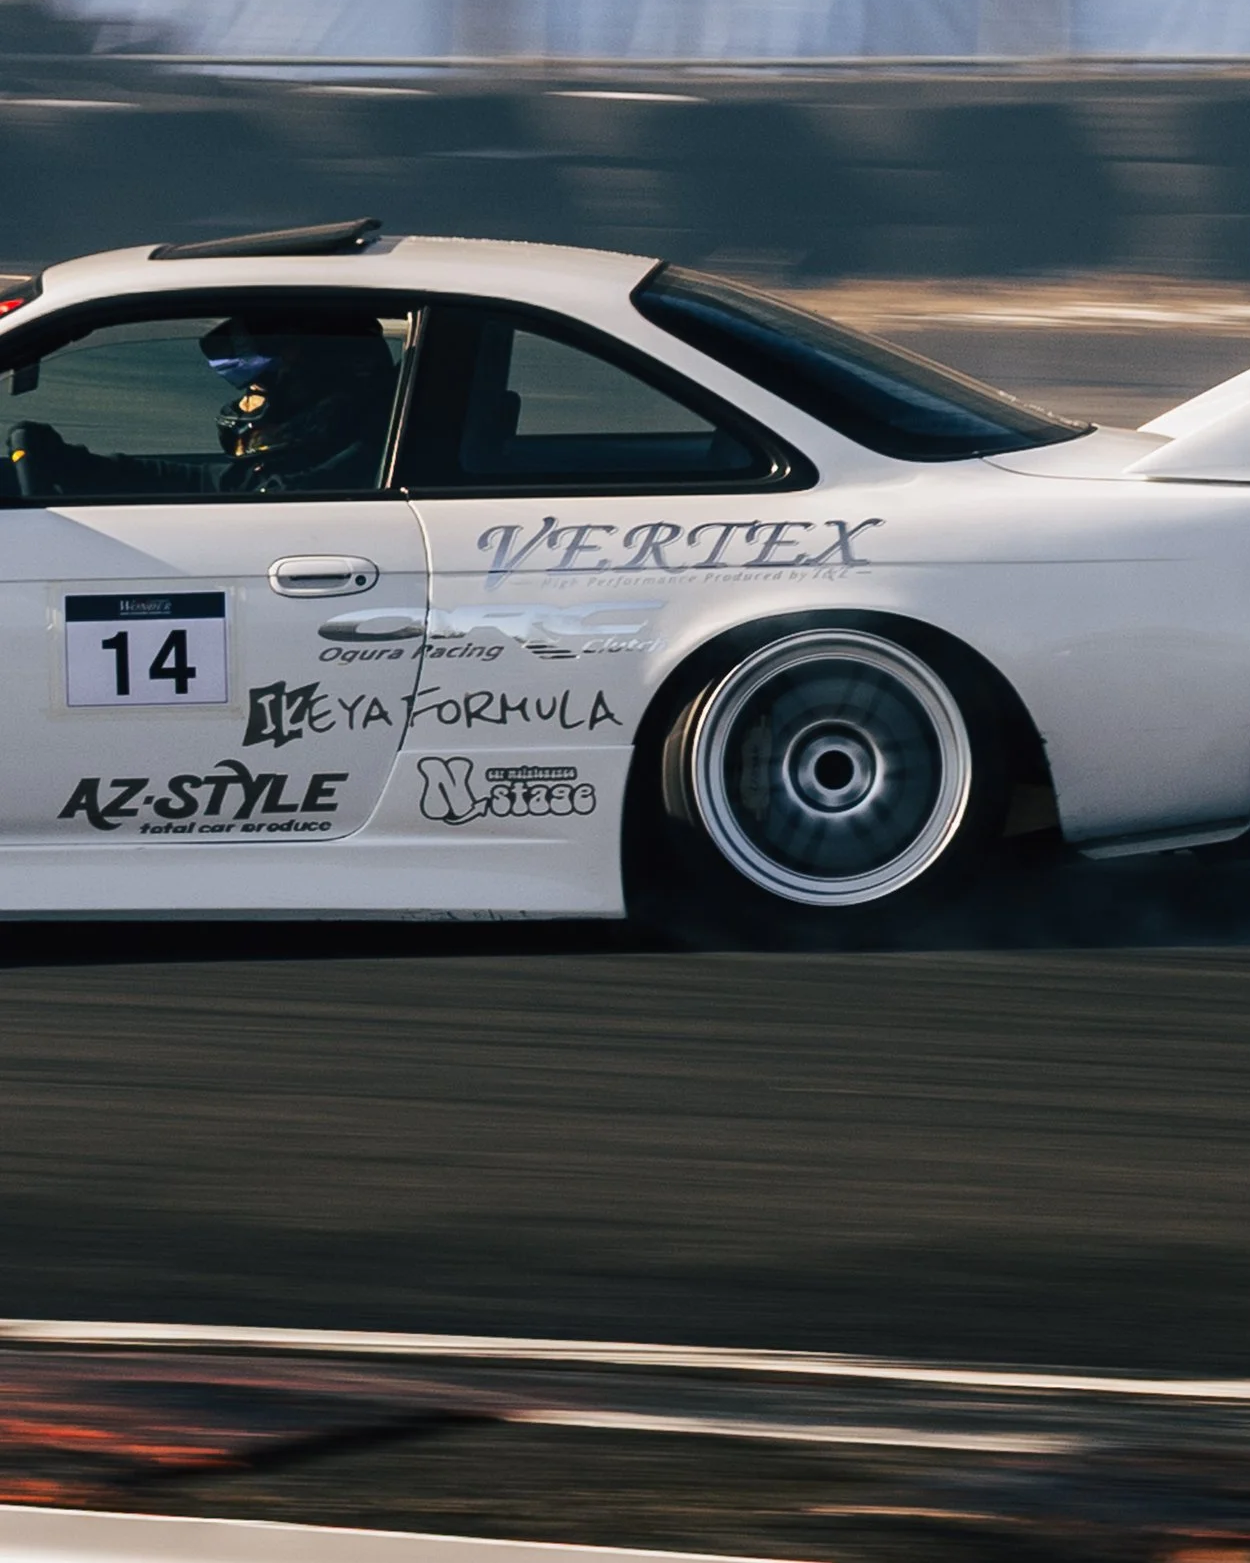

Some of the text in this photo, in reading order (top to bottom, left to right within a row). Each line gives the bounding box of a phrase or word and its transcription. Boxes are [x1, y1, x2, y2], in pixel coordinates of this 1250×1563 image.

[478, 516, 886, 590] VERTEX
[587, 574, 698, 588] Performance
[704, 570, 781, 583] Produced
[788, 569, 807, 582] by
[318, 642, 505, 665] Ogura Racing
[582, 637, 668, 654] Clutch
[101, 629, 197, 696] 14
[401, 686, 623, 730] FORMULA
[490, 782, 597, 817] stage
[140, 820, 332, 834] total car produce
